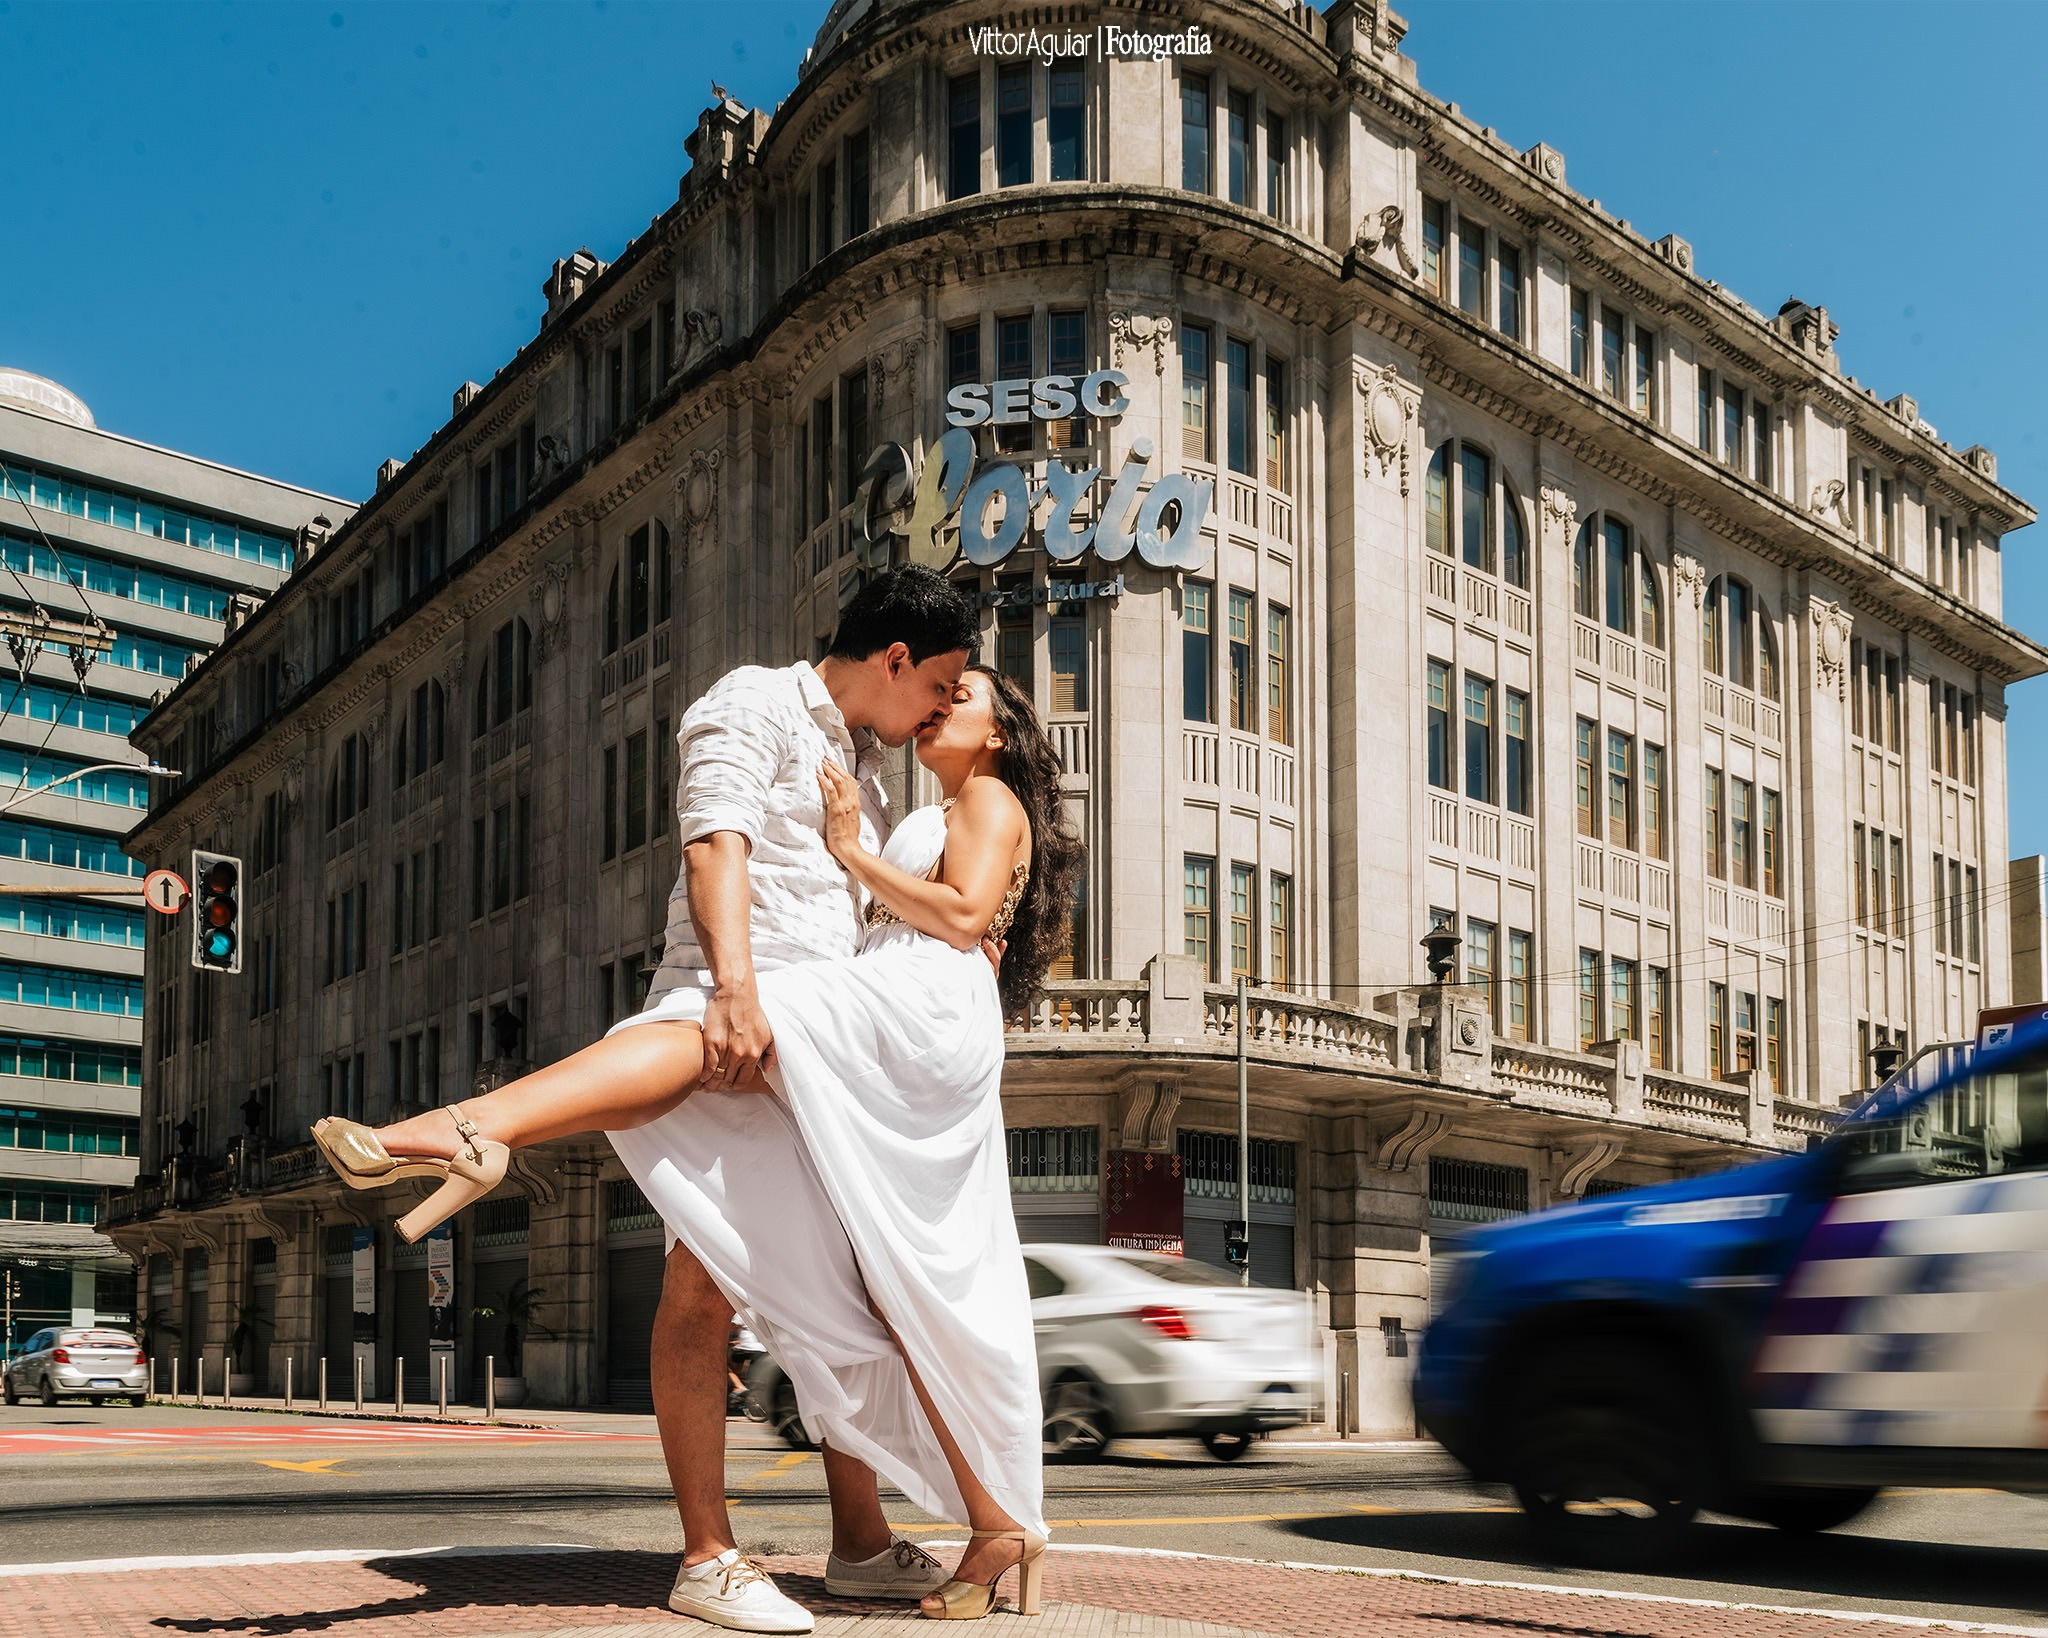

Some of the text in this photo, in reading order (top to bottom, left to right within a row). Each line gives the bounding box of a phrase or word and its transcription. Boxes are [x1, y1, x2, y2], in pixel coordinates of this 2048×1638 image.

[945, 369, 1131, 427] SESC
[1132, 1232, 1165, 1240] ENCONTROS
[1108, 1237, 1183, 1251] CULTURA INDÍGENA
